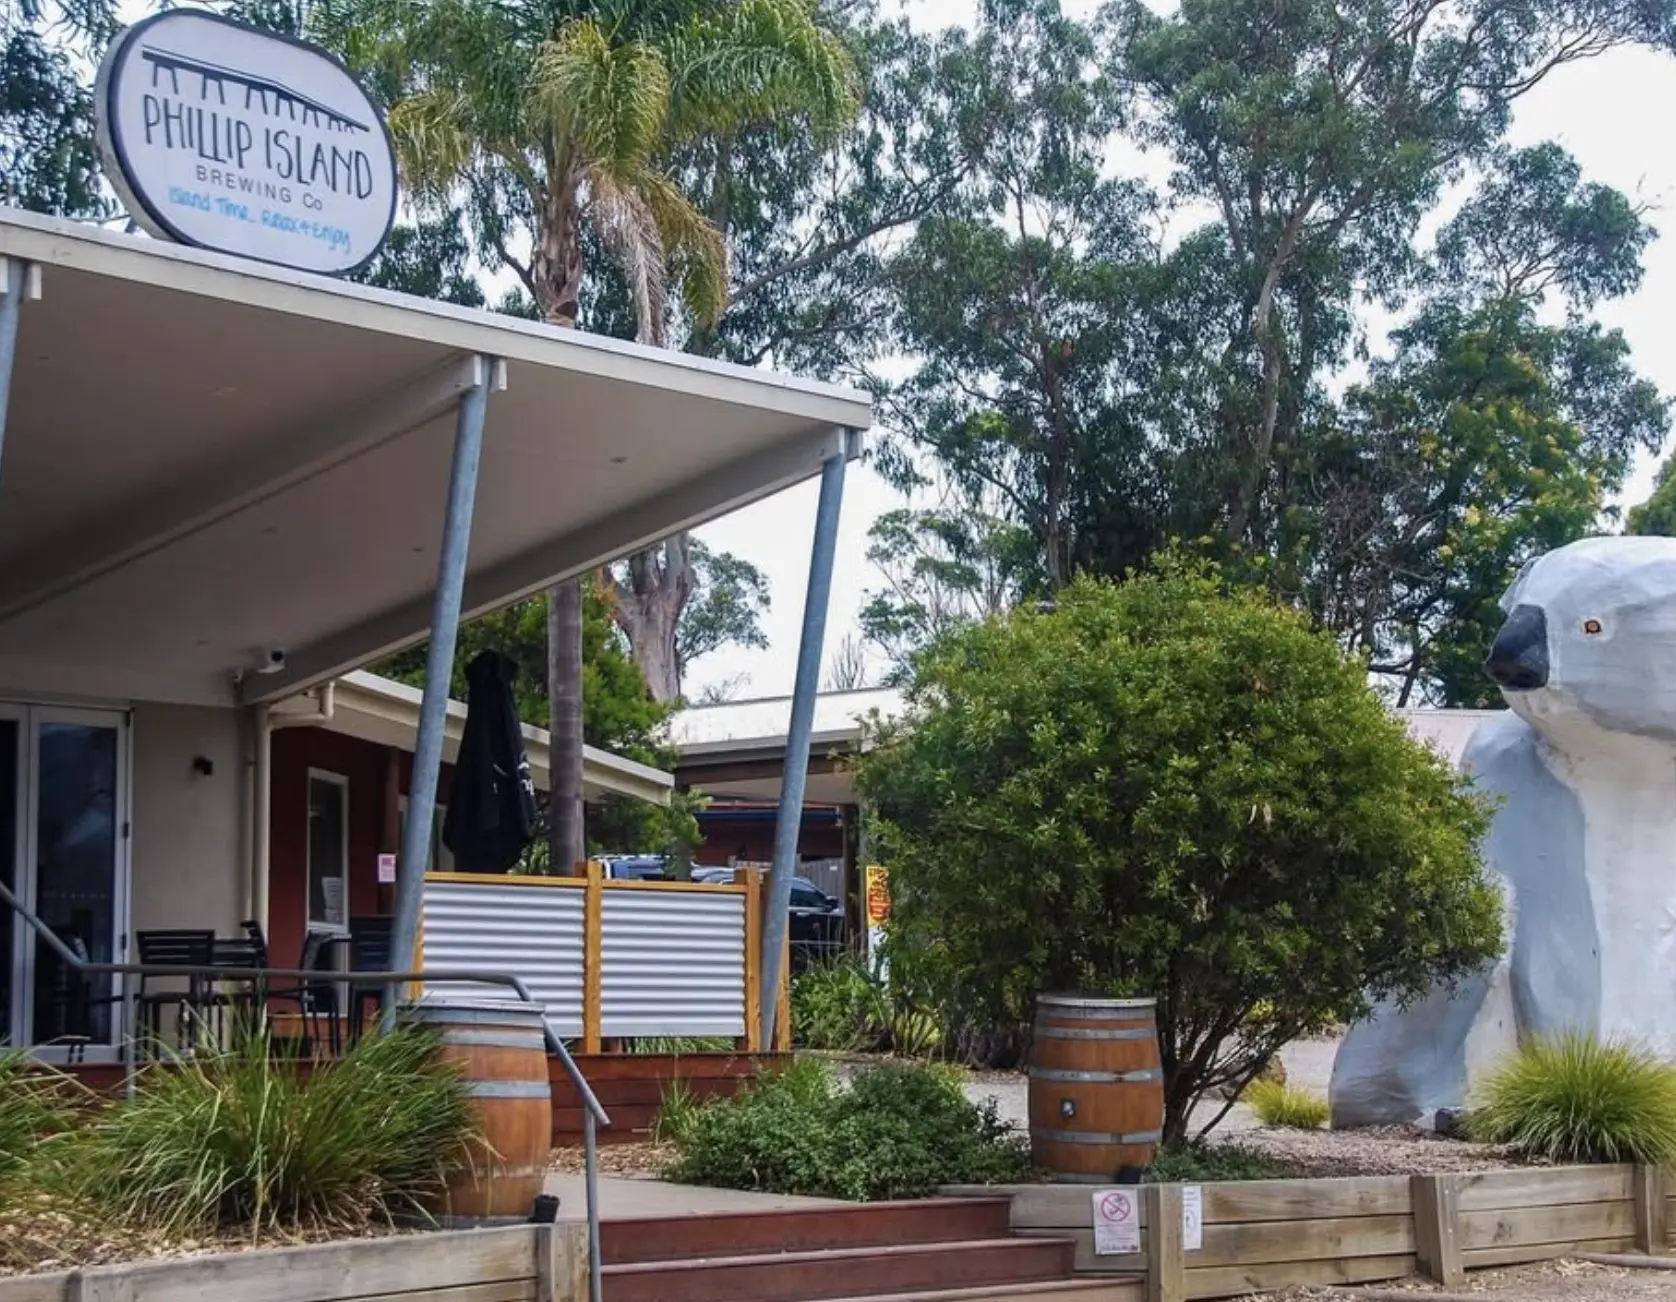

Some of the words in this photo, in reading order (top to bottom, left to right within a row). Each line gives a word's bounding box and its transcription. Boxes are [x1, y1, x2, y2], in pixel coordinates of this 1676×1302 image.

[144, 94, 253, 169] PHILLIP
[264, 127, 372, 200] ISLAND
[196, 164, 292, 203] BREWING
[302, 192, 323, 210] Co
